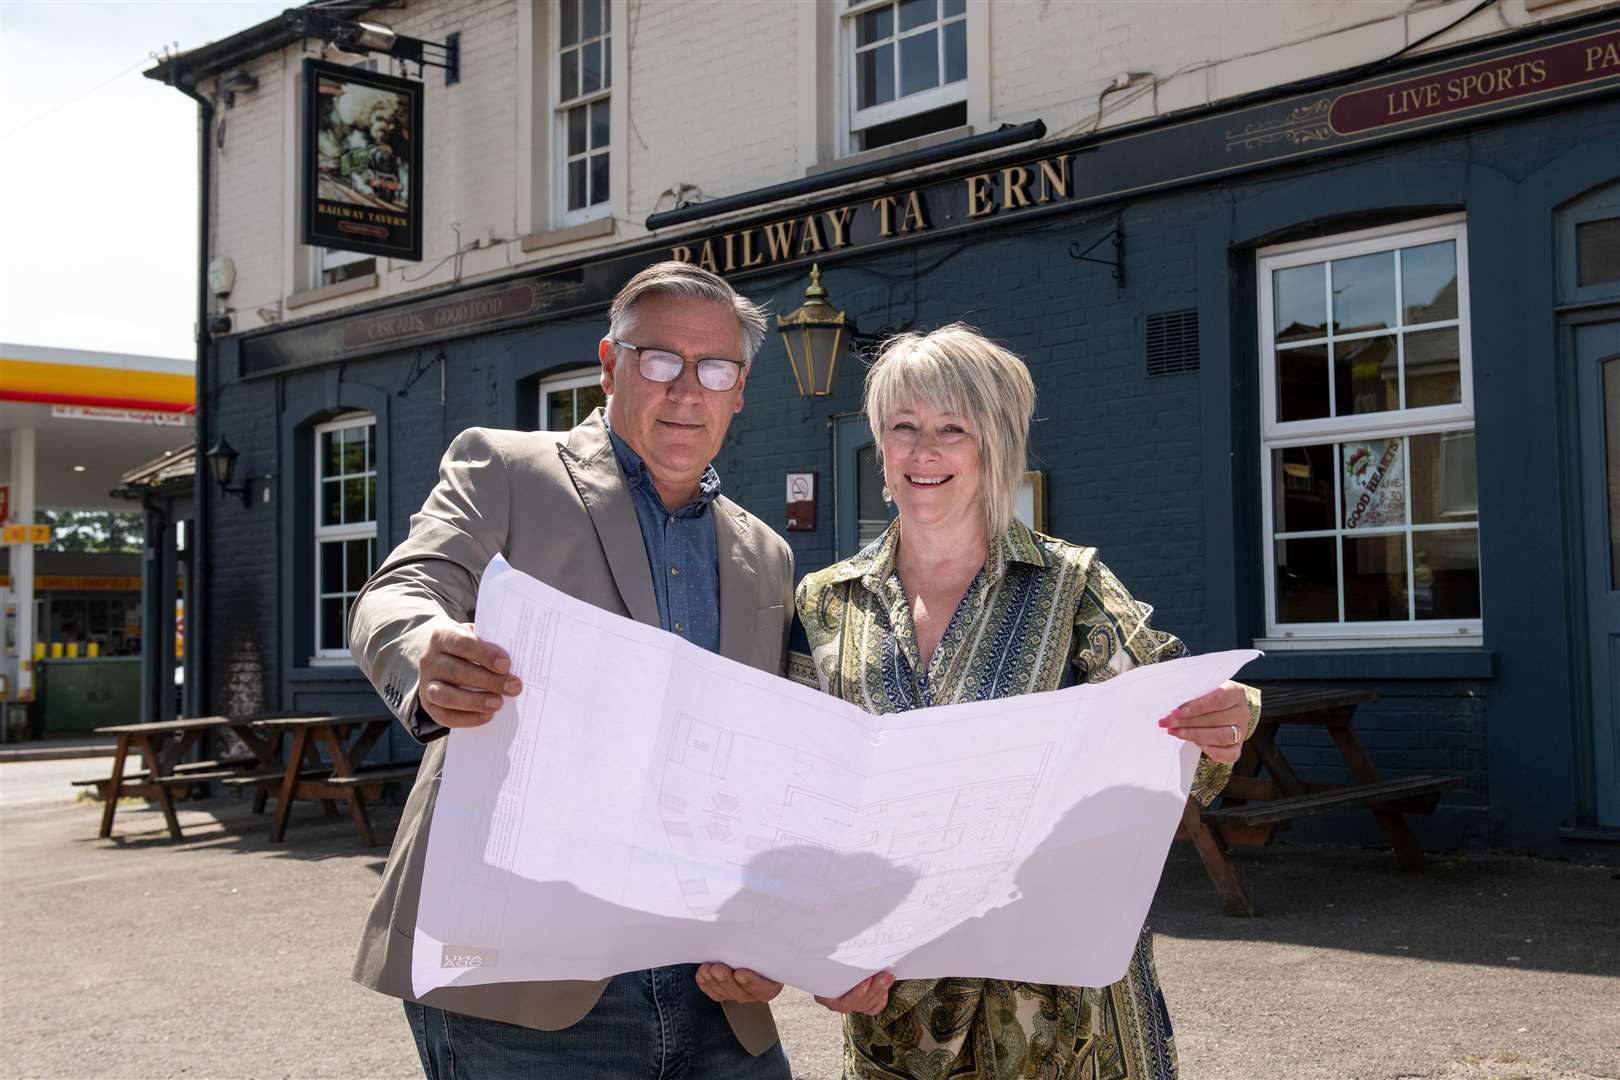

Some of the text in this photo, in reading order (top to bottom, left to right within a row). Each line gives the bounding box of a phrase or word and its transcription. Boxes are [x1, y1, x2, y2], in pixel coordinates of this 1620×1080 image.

[1387, 42, 1620, 117] LIVE SPORTS PA
[318, 203, 408, 227] RAILWAY TAVERN
[434, 305, 468, 326] GOOD
[469, 298, 502, 320] FOOD
[1347, 493, 1370, 529] GOOD
